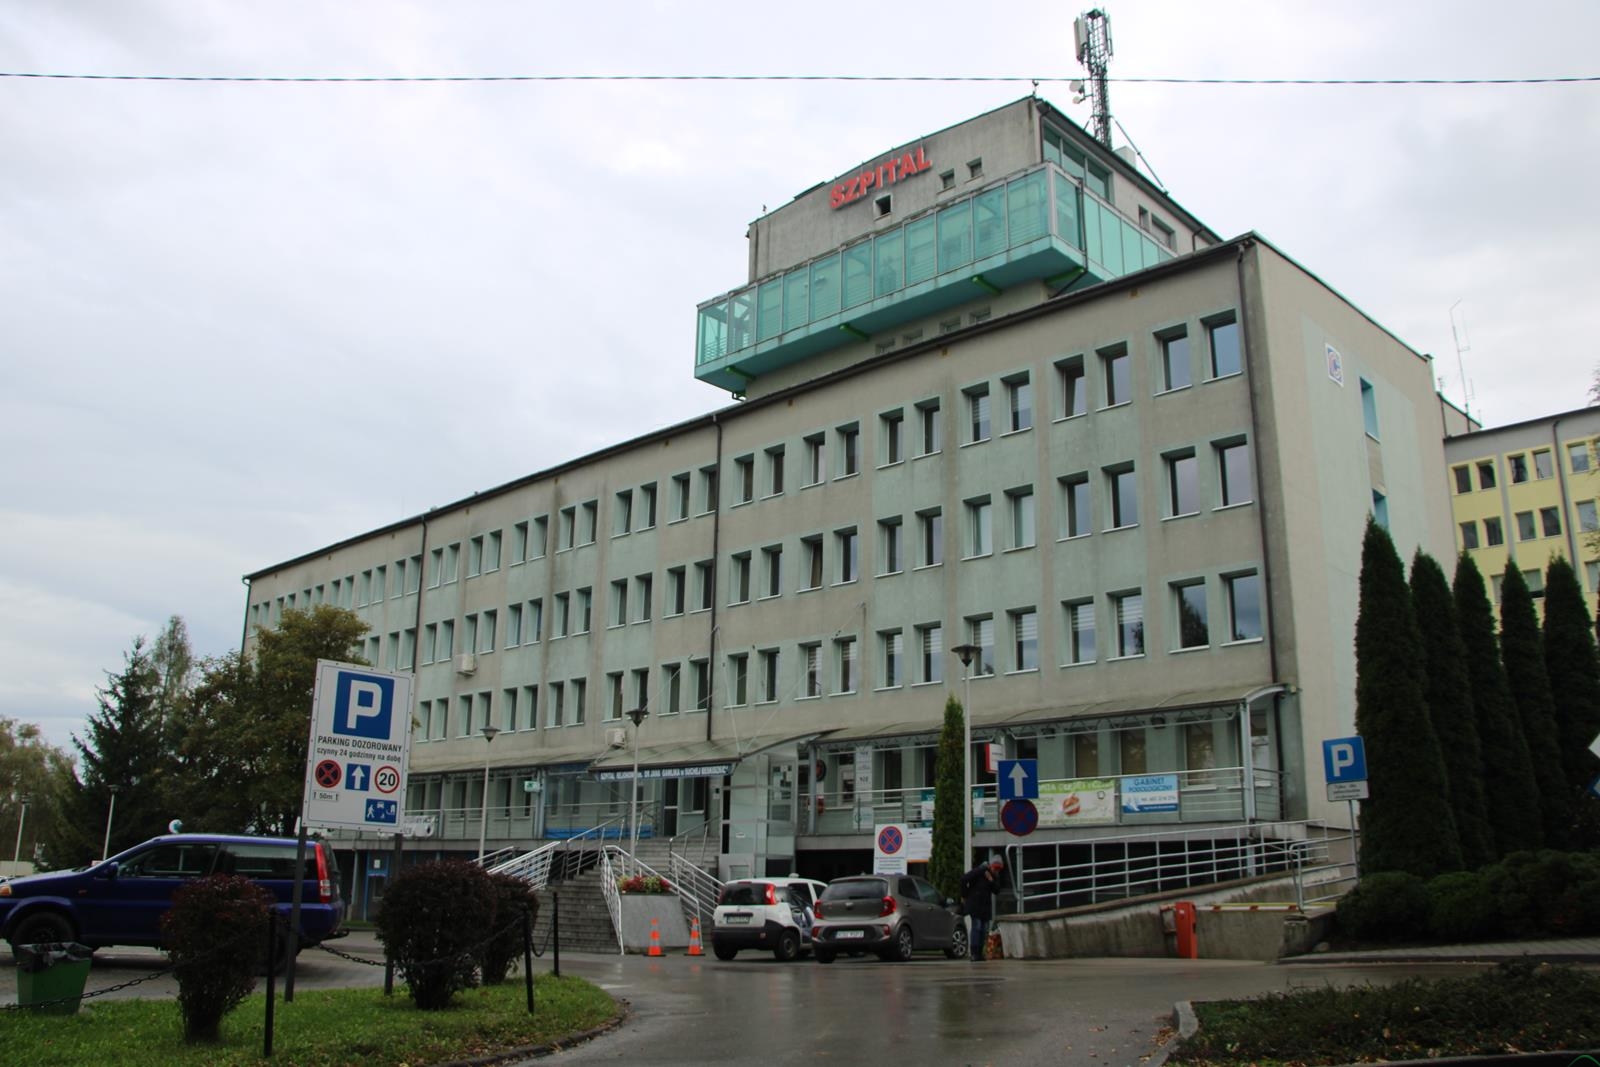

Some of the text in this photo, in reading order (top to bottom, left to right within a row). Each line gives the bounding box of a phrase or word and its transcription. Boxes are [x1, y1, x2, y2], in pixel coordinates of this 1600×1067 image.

[830, 146, 932, 209] SZPITAL
[347, 679, 382, 729] P
[318, 735, 402, 752] PARKING DOZOROWANY
[339, 748, 347, 756] 24
[1331, 743, 1354, 777] P
[379, 772, 396, 787] 20
